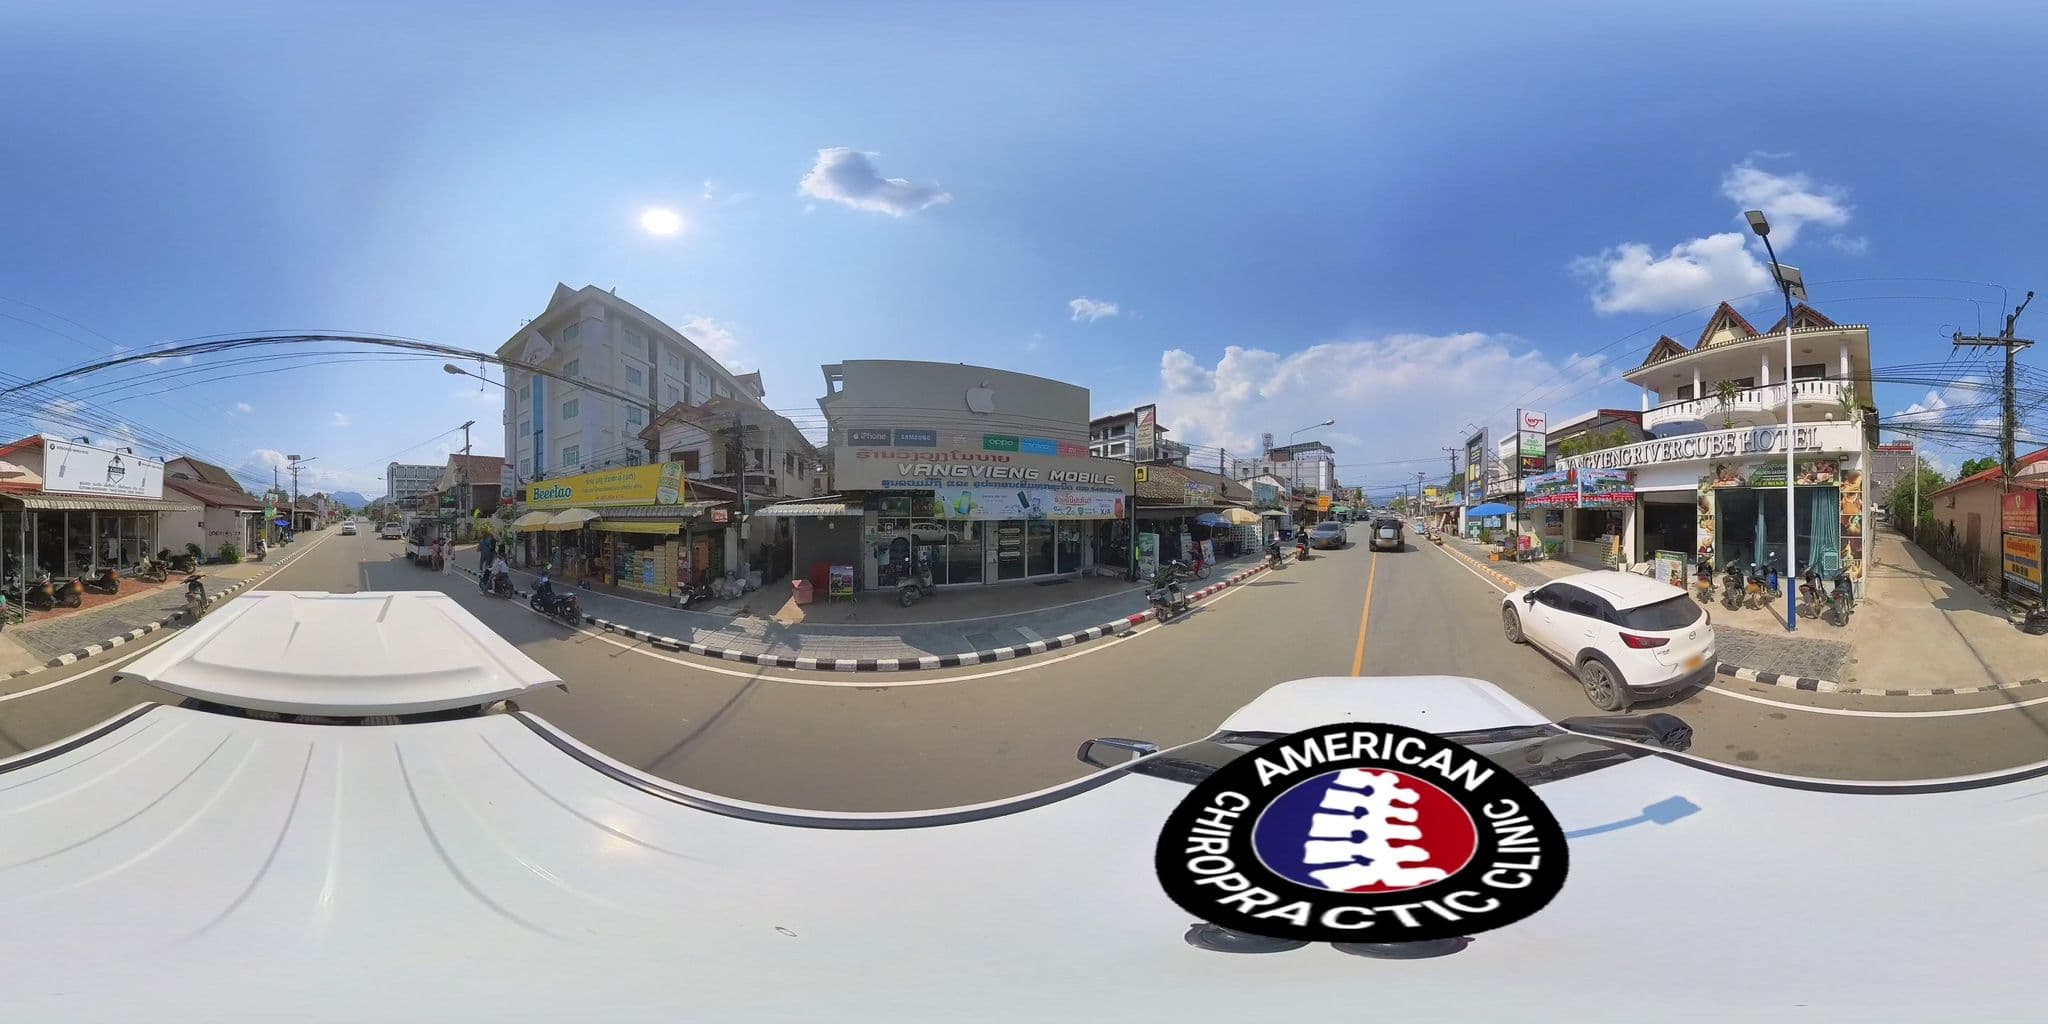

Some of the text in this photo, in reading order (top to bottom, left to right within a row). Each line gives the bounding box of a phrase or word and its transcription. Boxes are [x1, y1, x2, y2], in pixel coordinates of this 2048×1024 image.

[860, 431, 887, 441] iPhone
[900, 432, 931, 441] SAMSUNG
[1740, 427, 1822, 453] HOTEL
[898, 463, 1116, 485] VANGVIENG MOBILE
